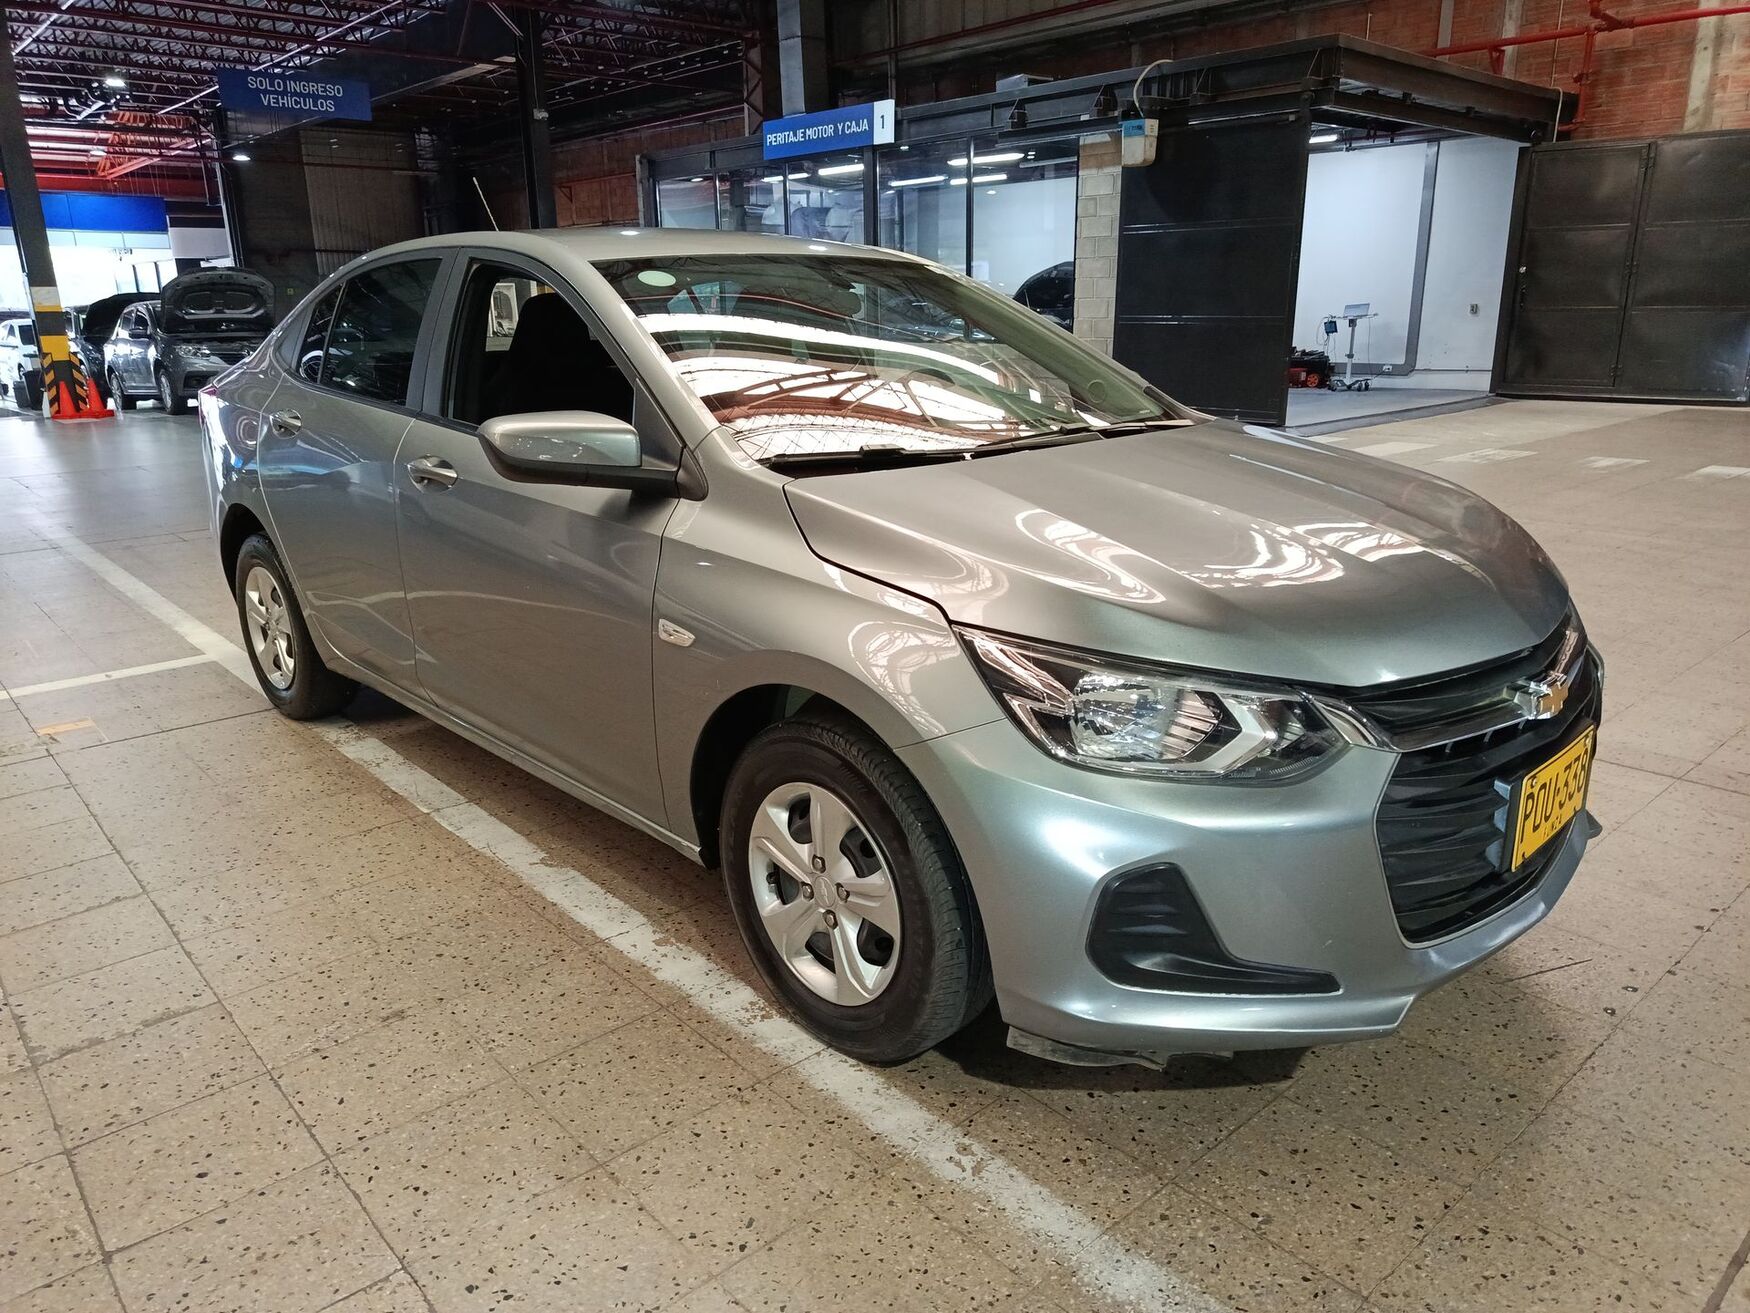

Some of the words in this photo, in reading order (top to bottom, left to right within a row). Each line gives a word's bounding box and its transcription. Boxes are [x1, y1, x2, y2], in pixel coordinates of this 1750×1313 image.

[247, 76, 284, 92] SOLO
[286, 80, 343, 97] INGRESO
[260, 93, 335, 112] VEHÍCULOS
[879, 114, 885, 129] 1
[766, 128, 805, 146] PERITAJE
[805, 124, 834, 140] MOTOR
[837, 122, 843, 135] Y
[844, 118, 869, 134] CAJA
